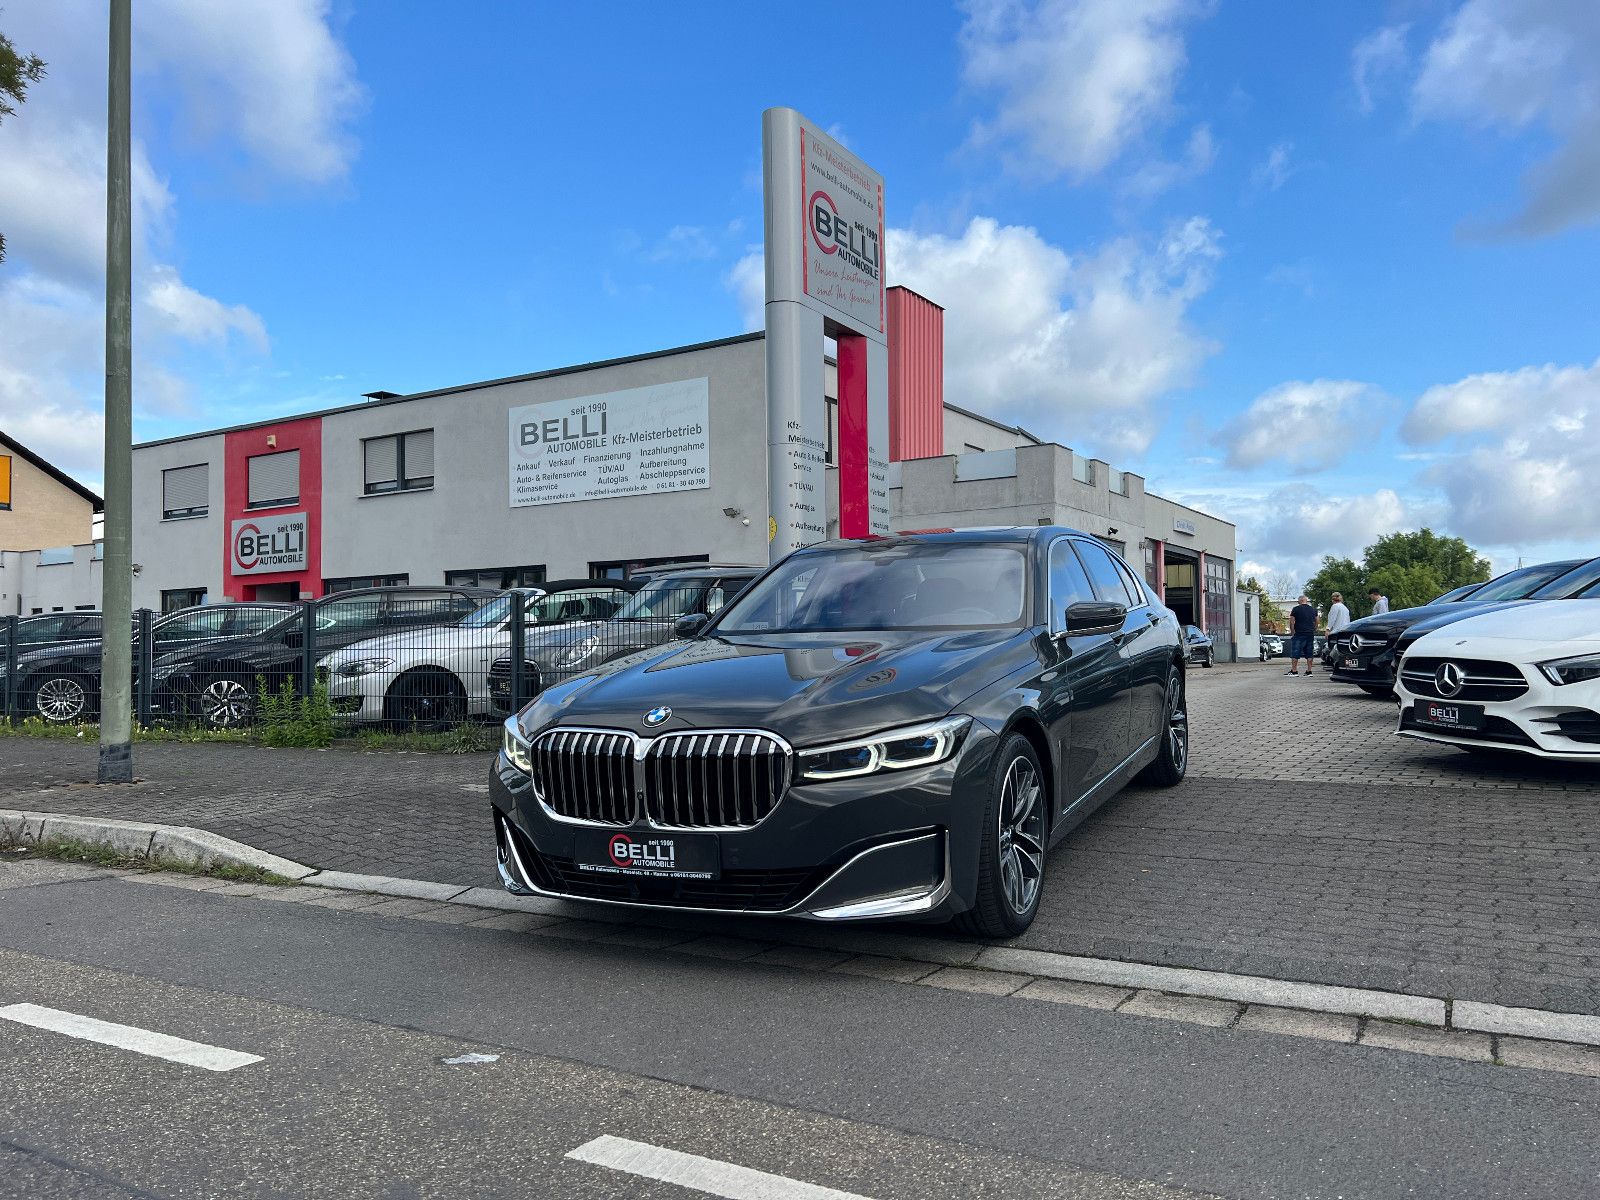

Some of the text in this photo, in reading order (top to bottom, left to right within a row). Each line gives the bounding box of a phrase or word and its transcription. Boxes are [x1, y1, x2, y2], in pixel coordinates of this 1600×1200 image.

[812, 141, 871, 192] Kfz-Meisterbetrieb
[816, 205, 878, 268] BELLI
[855, 221, 878, 242] seit 1990
[838, 247, 878, 280] AUTOMOBILE
[571, 402, 607, 416] seit 1990
[520, 412, 607, 446] BELLI
[612, 424, 702, 445] Kfz-Meisterbetrieb
[787, 421, 801, 429] Kfz-
[547, 437, 607, 454] AUTOMOBILE
[788, 435, 825, 450] Meisterbetrieb
[517, 442, 704, 471] Ankauf Verkauf Finanzierung Inzahlungnahme
[517, 473, 534, 484] Auto-
[542, 469, 587, 481] Reifenservice
[598, 464, 625, 474] TÜV/AU
[640, 458, 687, 471] Aufbereitung
[517, 466, 706, 494] Klimaservice Autoglas Abschleppservice
[290, 523, 303, 531] 1990
[241, 531, 303, 557] BELLI
[259, 554, 302, 565] AUTOMOBILE
[1430, 708, 1458, 719] BELLI
[614, 842, 674, 860] BELLI
